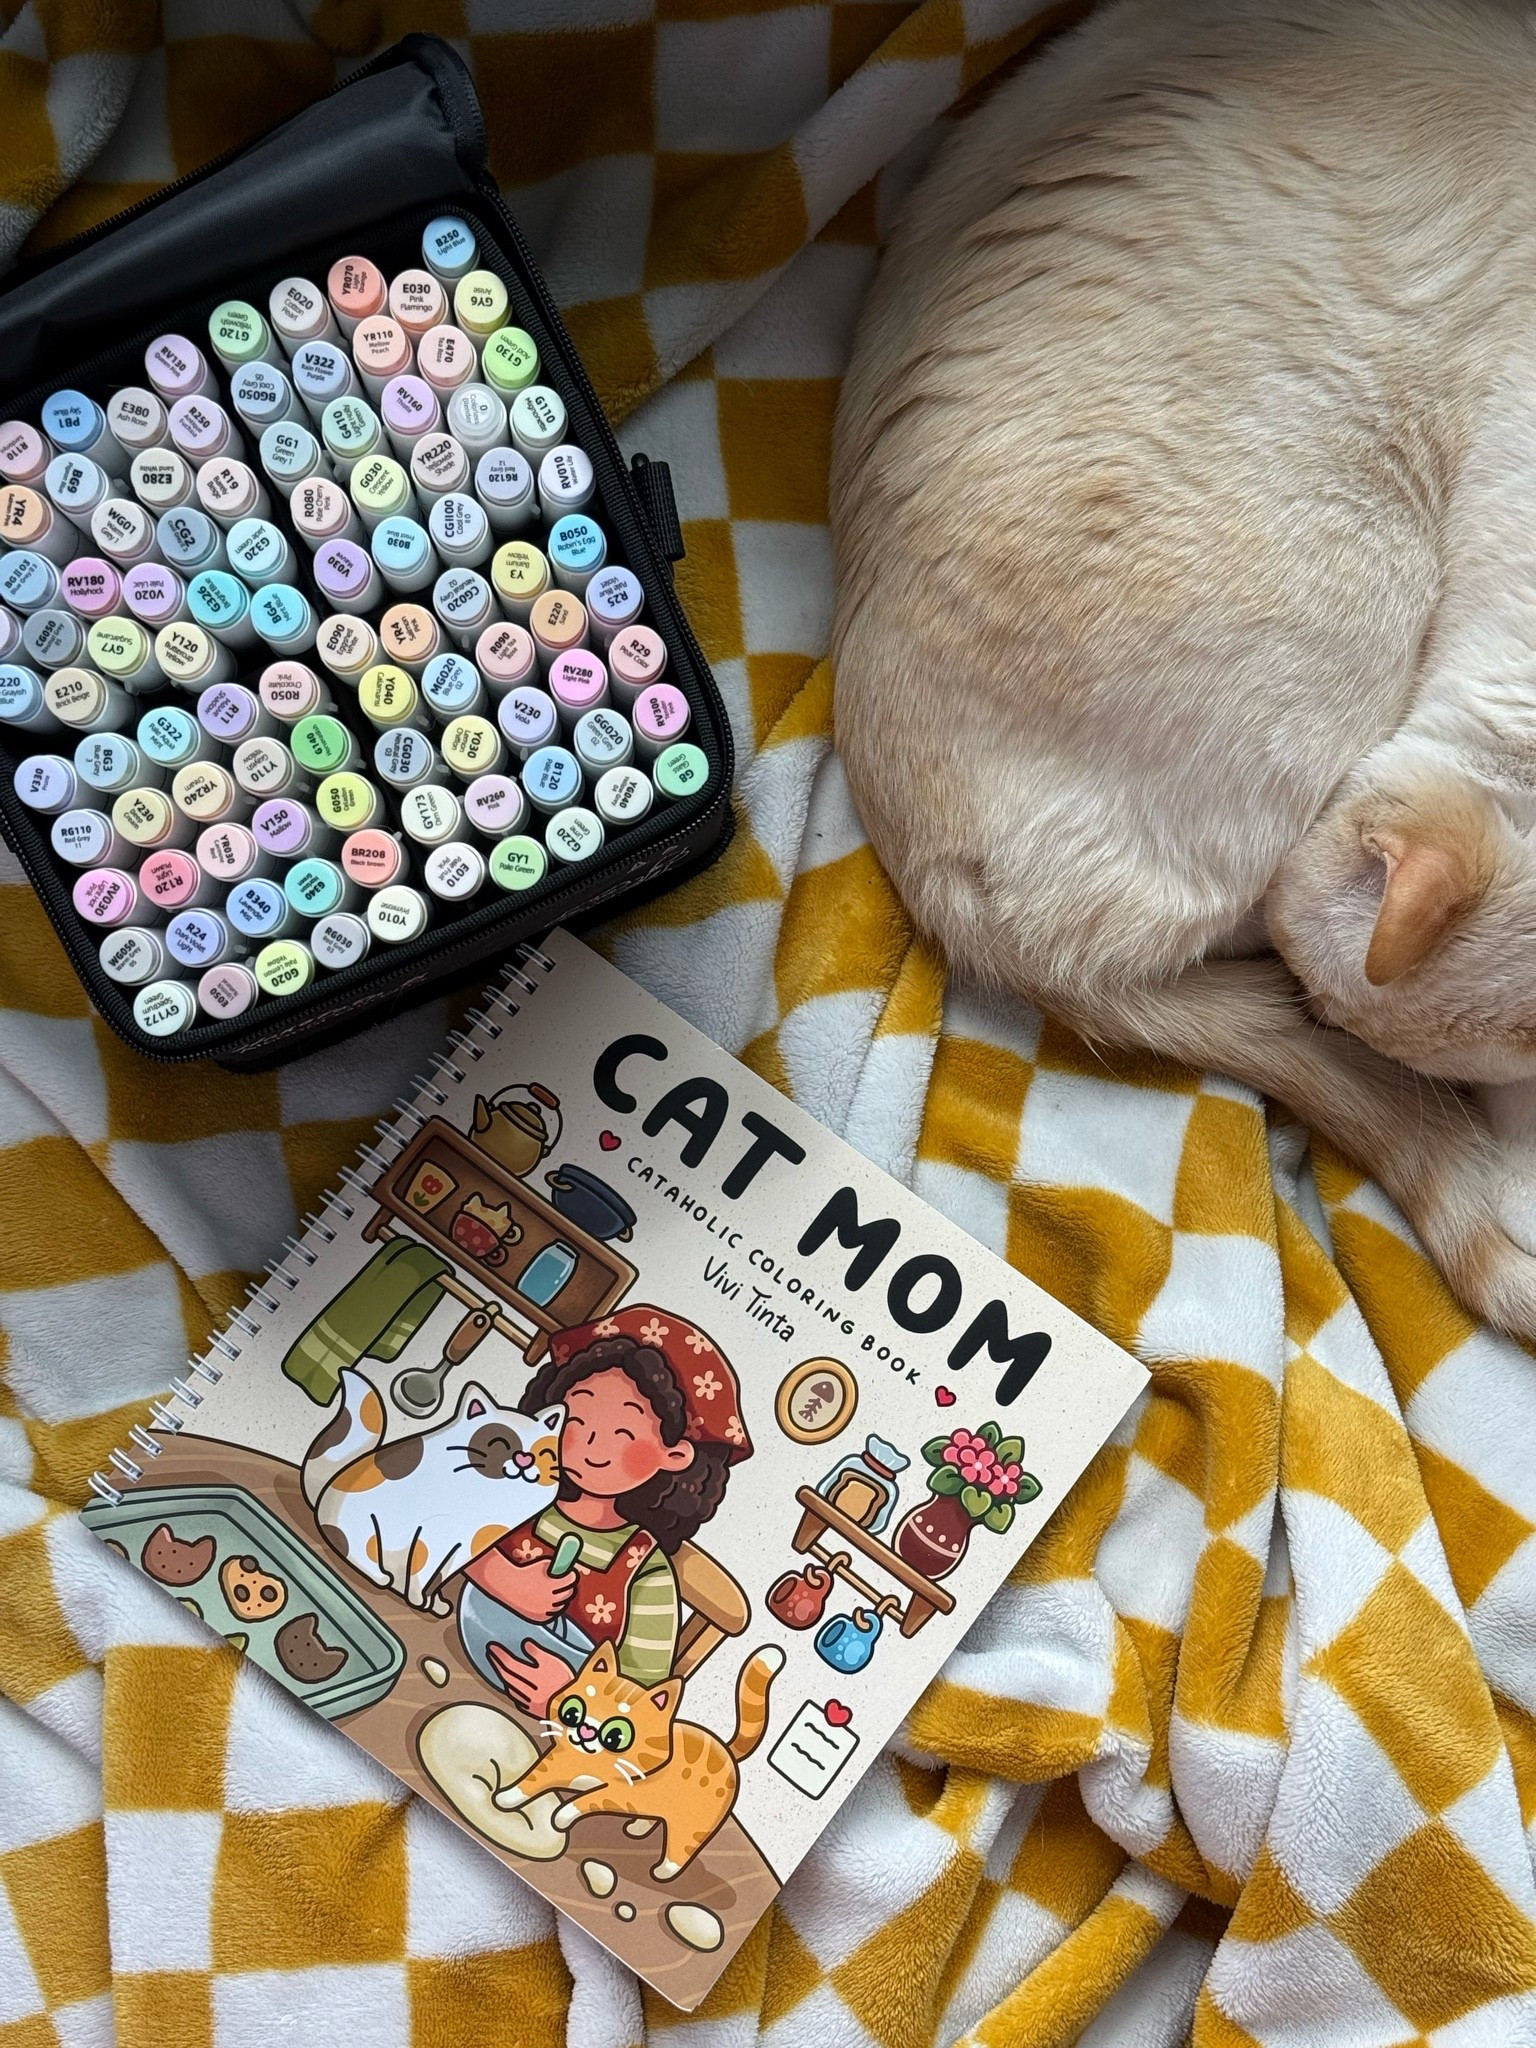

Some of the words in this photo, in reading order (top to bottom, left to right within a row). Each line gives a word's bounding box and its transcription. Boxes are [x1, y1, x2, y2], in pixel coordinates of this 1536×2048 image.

[435, 229, 459, 247] B250
[342, 265, 354, 295] YR070
[402, 284, 431, 294] E030
[284, 298, 304, 315] Cotton
[287, 287, 314, 310] E020
[400, 304, 433, 312] Flamingo
[471, 296, 493, 307] GY6
[220, 318, 252, 330] Yellowish
[228, 311, 248, 321] Green
[281, 306, 299, 321] Pearl
[220, 327, 249, 341] G120
[363, 330, 394, 341] YR110
[500, 334, 518, 349] Green
[160, 346, 186, 371] RV130
[305, 353, 335, 369] V322
[444, 338, 455, 363] E470
[496, 344, 522, 367] G130
[515, 346, 531, 359] Acid
[242, 379, 260, 390] Grey
[260, 381, 274, 390] Cool
[239, 389, 276, 402] BG050
[396, 387, 423, 412] RV160
[117, 413, 131, 422] Ash
[131, 417, 148, 427] Rose
[121, 402, 150, 417] E380
[189, 406, 211, 429] R250
[525, 397, 547, 432] Mignonette
[535, 396, 555, 423] G110
[59, 417, 80, 428] PB1
[333, 411, 352, 439] G410
[7, 441, 29, 461] R110
[275, 445, 295, 457] Green
[276, 435, 299, 449] GG1
[272, 453, 288, 464] Grey
[417, 440, 451, 466] YR220
[425, 452, 455, 472] Yellowish
[142, 474, 172, 484] E280
[220, 468, 239, 490] R19
[360, 462, 383, 489] G030
[434, 461, 455, 477] Shade
[488, 474, 518, 483] RG120
[554, 456, 571, 489] RV010
[67, 468, 83, 493] BG9
[368, 469, 391, 494] Crescent
[377, 477, 394, 497] Yellow
[13, 499, 26, 526] YR4
[304, 489, 314, 518] R080
[108, 507, 136, 534] WG01
[175, 519, 195, 547] CG2
[250, 525, 265, 541] Jade
[387, 538, 410, 549] B030
[559, 526, 588, 542] B050
[235, 538, 254, 554] Green
[244, 537, 270, 561] G320
[558, 540, 582, 552] Robin's
[583, 536, 596, 546] Egg
[571, 548, 586, 556] Blue
[327, 557, 350, 578] V030
[510, 570, 524, 579] Y3
[67, 575, 105, 587] RV180
[70, 588, 104, 596] Hollyhock
[135, 590, 165, 600] V020
[197, 586, 221, 613] G326
[447, 586, 479, 611] CG020
[607, 591, 628, 607] R25
[263, 601, 282, 624] BG4
[548, 602, 562, 626] E220
[36, 620, 56, 647] CG050
[96, 631, 133, 645] Sugarcane
[171, 632, 199, 653] Y120
[326, 624, 345, 651] E090
[391, 622, 406, 645] YR4
[490, 632, 510, 654] R090
[101, 642, 124, 655] GY7
[164, 641, 194, 662] Buttercup
[165, 651, 186, 666] Yellow
[630, 640, 650, 657] R29
[430, 658, 456, 695] MG020
[563, 665, 592, 678] RV280
[55, 682, 83, 699] E210
[56, 697, 72, 709] Brick
[71, 691, 91, 703] Beige
[271, 691, 300, 700] R050
[374, 672, 385, 707] Calamansi
[384, 677, 395, 705] Y040
[221, 704, 239, 724] R11
[513, 700, 541, 719] V230
[514, 713, 531, 725] Viola
[649, 697, 665, 727] RV300
[157, 717, 183, 742] G322
[594, 714, 624, 745] GG020
[306, 732, 323, 756] G140
[399, 736, 413, 773] CG030
[467, 731, 483, 759] Y030
[103, 749, 113, 772] BG3
[30, 768, 44, 793] V330
[250, 761, 279, 783] Y110
[548, 761, 564, 790] B120
[678, 769, 694, 783] G8
[183, 775, 206, 792] Cream
[184, 780, 218, 805] YR240
[330, 788, 343, 813] G050
[476, 790, 506, 807] RV260
[619, 780, 638, 809] YG040
[133, 798, 155, 822] Y230
[260, 809, 289, 832] V150
[415, 794, 434, 830] GY173
[61, 825, 92, 837] RG110
[269, 821, 292, 838] Mallow
[556, 828, 581, 852] G220
[219, 833, 236, 865] YR030
[351, 848, 386, 859] BR208
[507, 852, 529, 864] GY1
[155, 876, 184, 894] R120
[446, 862, 470, 888] E010
[94, 882, 121, 916] RV030
[245, 889, 271, 914] B340
[304, 881, 326, 901] G340
[238, 897, 264, 922] Lavender
[378, 910, 408, 926] Y010
[380, 901, 410, 915] Primrose
[185, 923, 207, 942] R24
[324, 927, 354, 949] RG030
[107, 939, 136, 967] WG050
[270, 967, 300, 988] G020
[141, 996, 174, 1015] Spectrum
[143, 992, 164, 1005] Green
[209, 987, 230, 1008] E050
[143, 1004, 180, 1027] GY172
[593, 1034, 806, 1200] CAT
[797, 1186, 1052, 1407] MOM
[627, 1157, 743, 1250] CATAHOLIC
[748, 1248, 856, 1336] COLORING
[860, 1334, 923, 1386] BOOK
[703, 1256, 743, 1301] Vivi
[747, 1285, 796, 1343] Tinta
